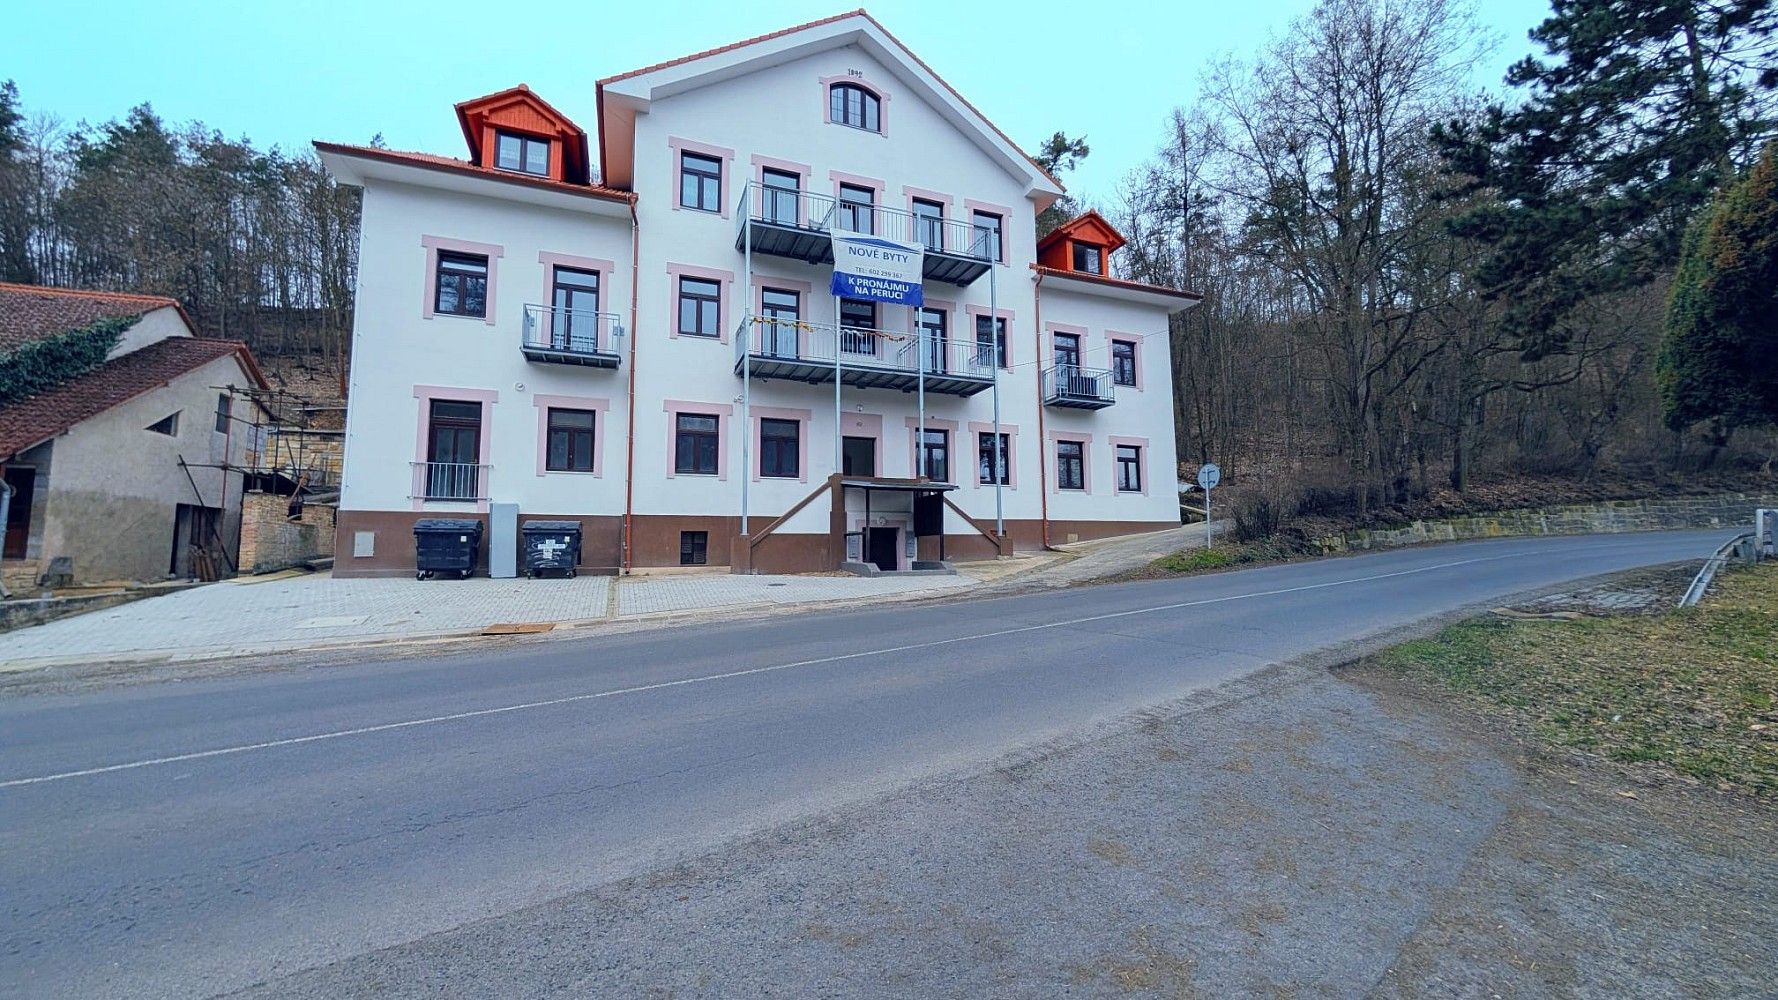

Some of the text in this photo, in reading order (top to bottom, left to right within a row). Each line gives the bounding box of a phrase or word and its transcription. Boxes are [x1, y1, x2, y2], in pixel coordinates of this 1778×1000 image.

[849, 247, 908, 262] NOVÉ BYTY
[857, 278, 909, 292] PRONÁJMU
[854, 286, 903, 300] NA PERUCI
